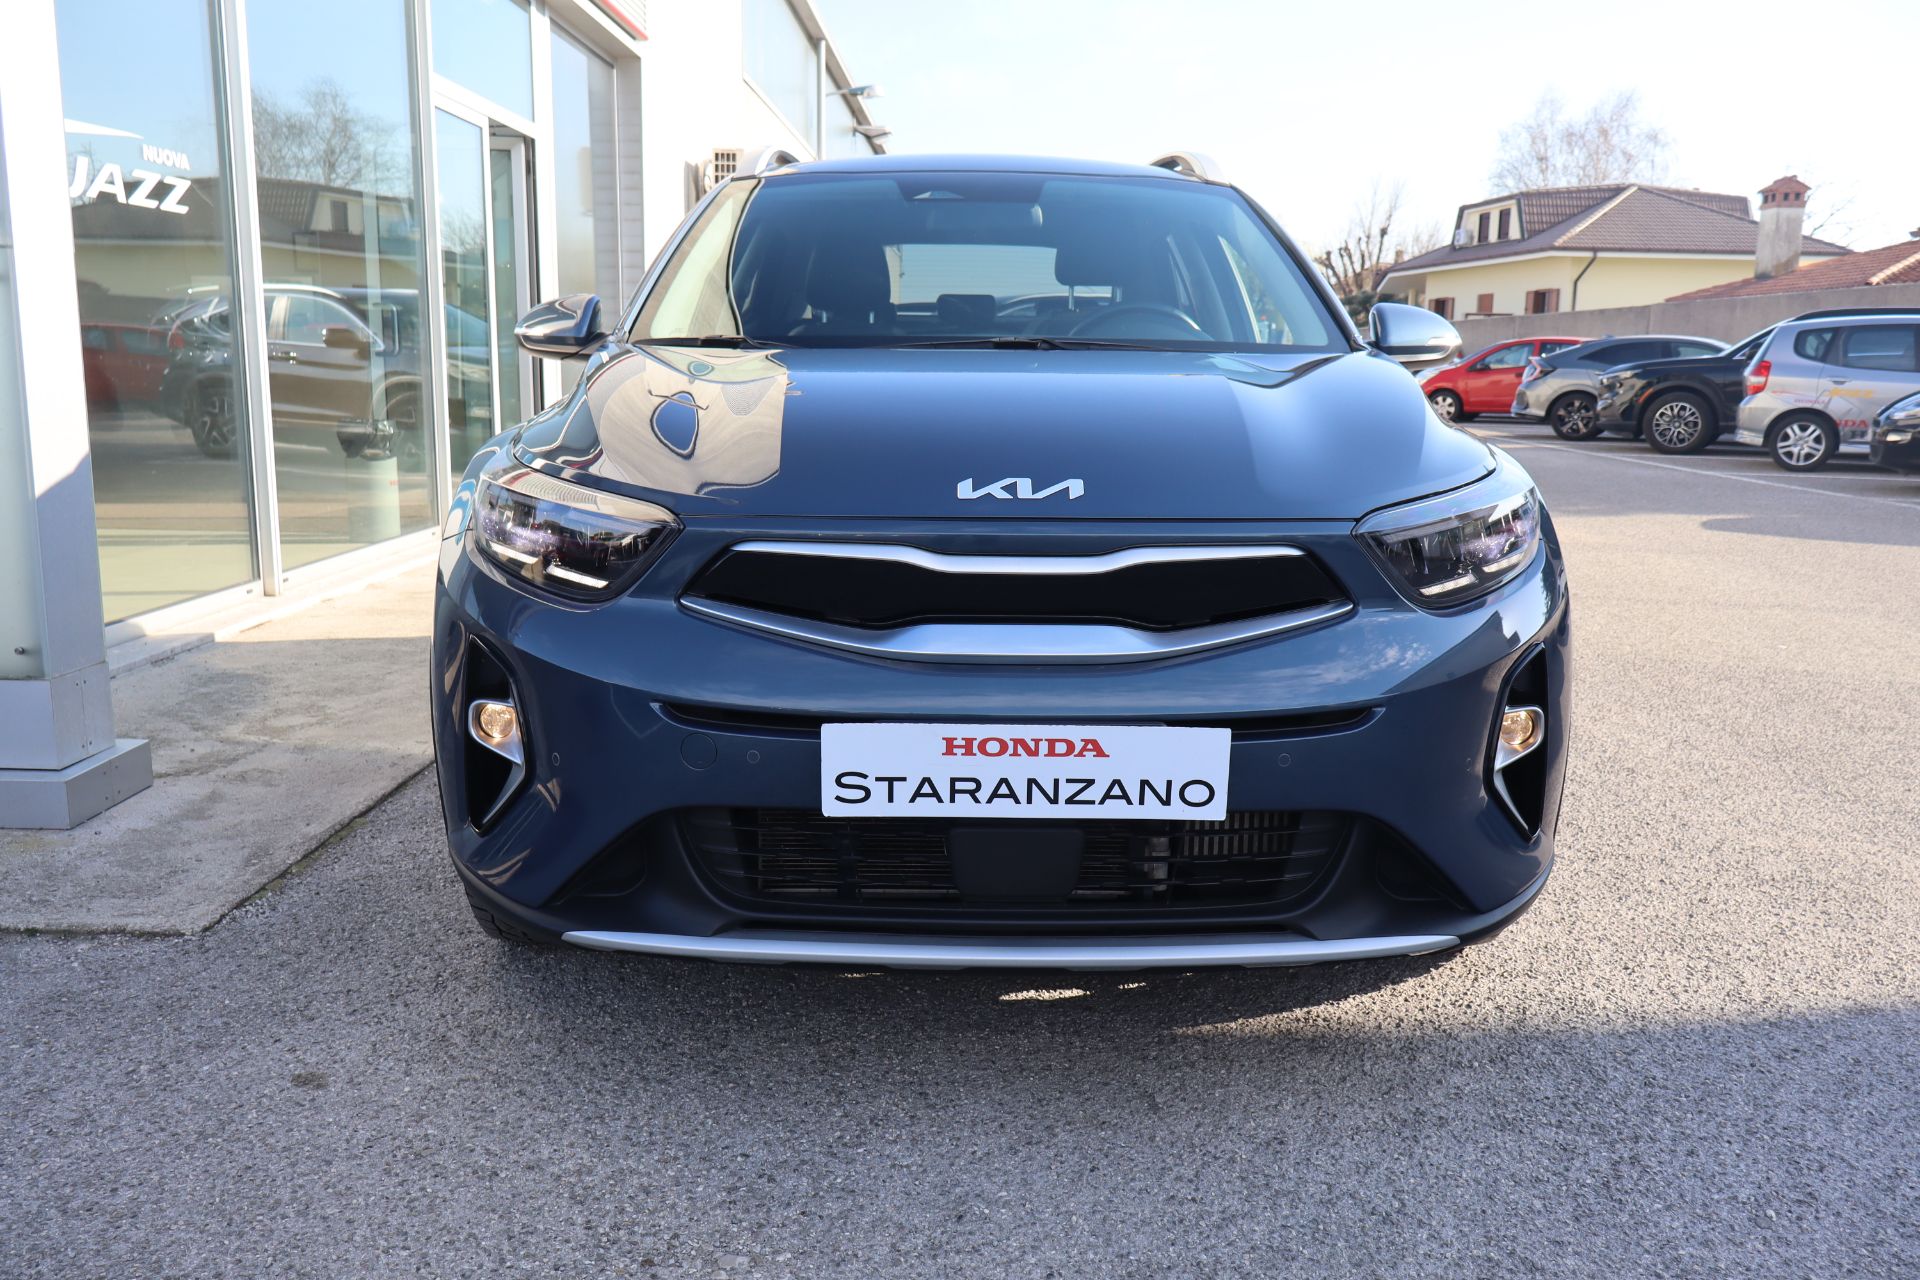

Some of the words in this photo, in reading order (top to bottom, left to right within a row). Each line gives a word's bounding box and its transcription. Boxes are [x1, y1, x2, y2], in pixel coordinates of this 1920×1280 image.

[142, 144, 191, 171] NUOVA
[69, 155, 191, 215] JAZZ
[957, 477, 1085, 500] KIA
[941, 736, 1110, 758] HONDA
[834, 771, 1216, 808] STARANZANO
